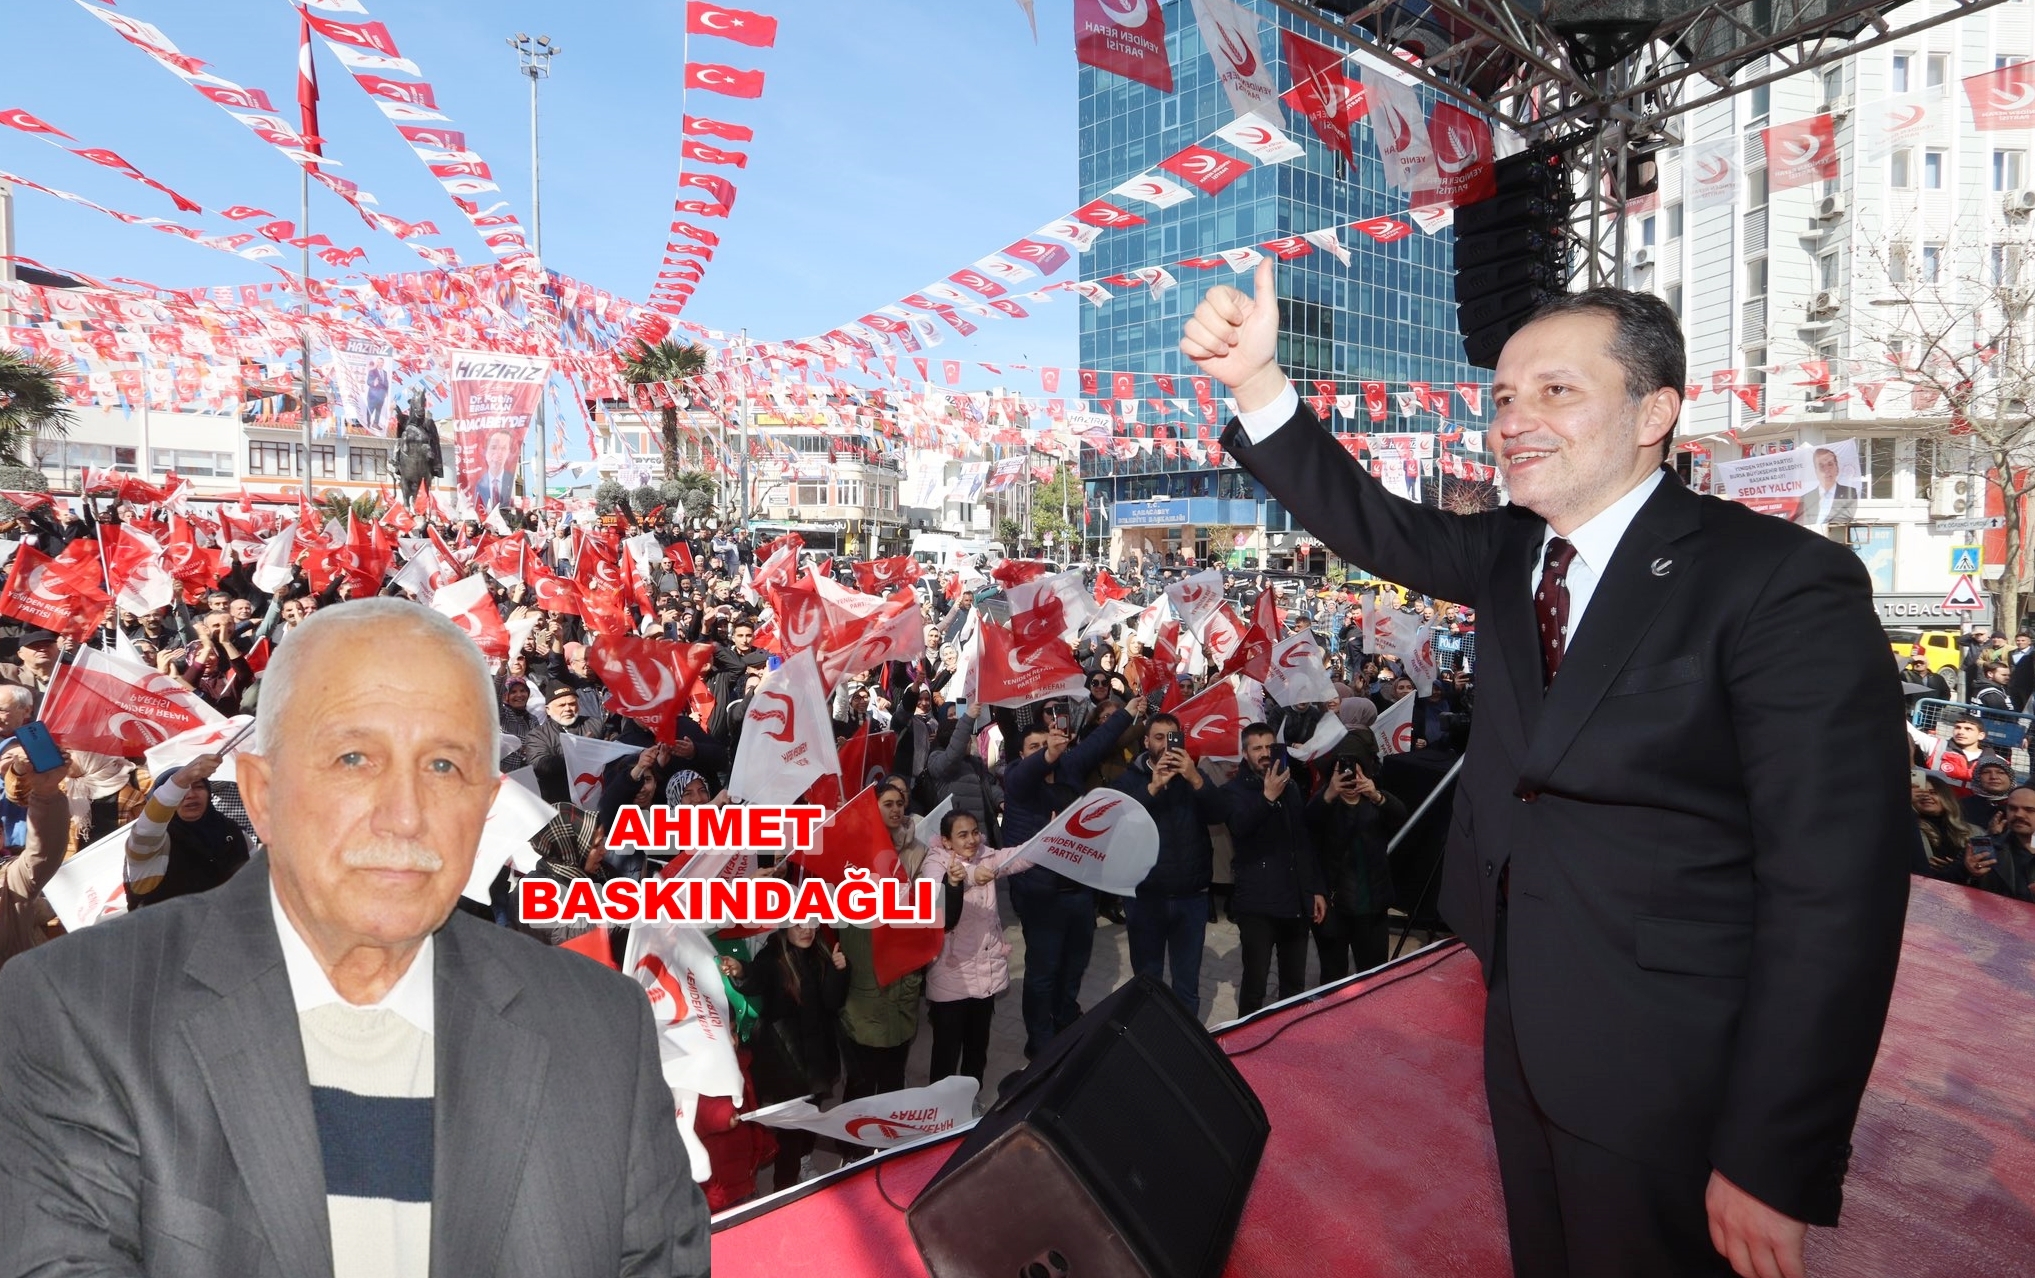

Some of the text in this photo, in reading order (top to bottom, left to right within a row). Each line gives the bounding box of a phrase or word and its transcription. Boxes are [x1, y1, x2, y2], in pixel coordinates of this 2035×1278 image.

[456, 360, 543, 381] HAZIRIZ
[1738, 481, 1802, 497] SEDAT YALÇIN
[8, 591, 72, 617] YENİDEN REFAH
[18, 604, 51, 619] PARTİSİ
[1439, 637, 1461, 650] POLİS
[1002, 672, 1031, 686] YENİDEN
[1017, 674, 1041, 689] PARTİSİ
[1048, 845, 1083, 865] PARTİSİ
[1076, 843, 1107, 862] REFAH
